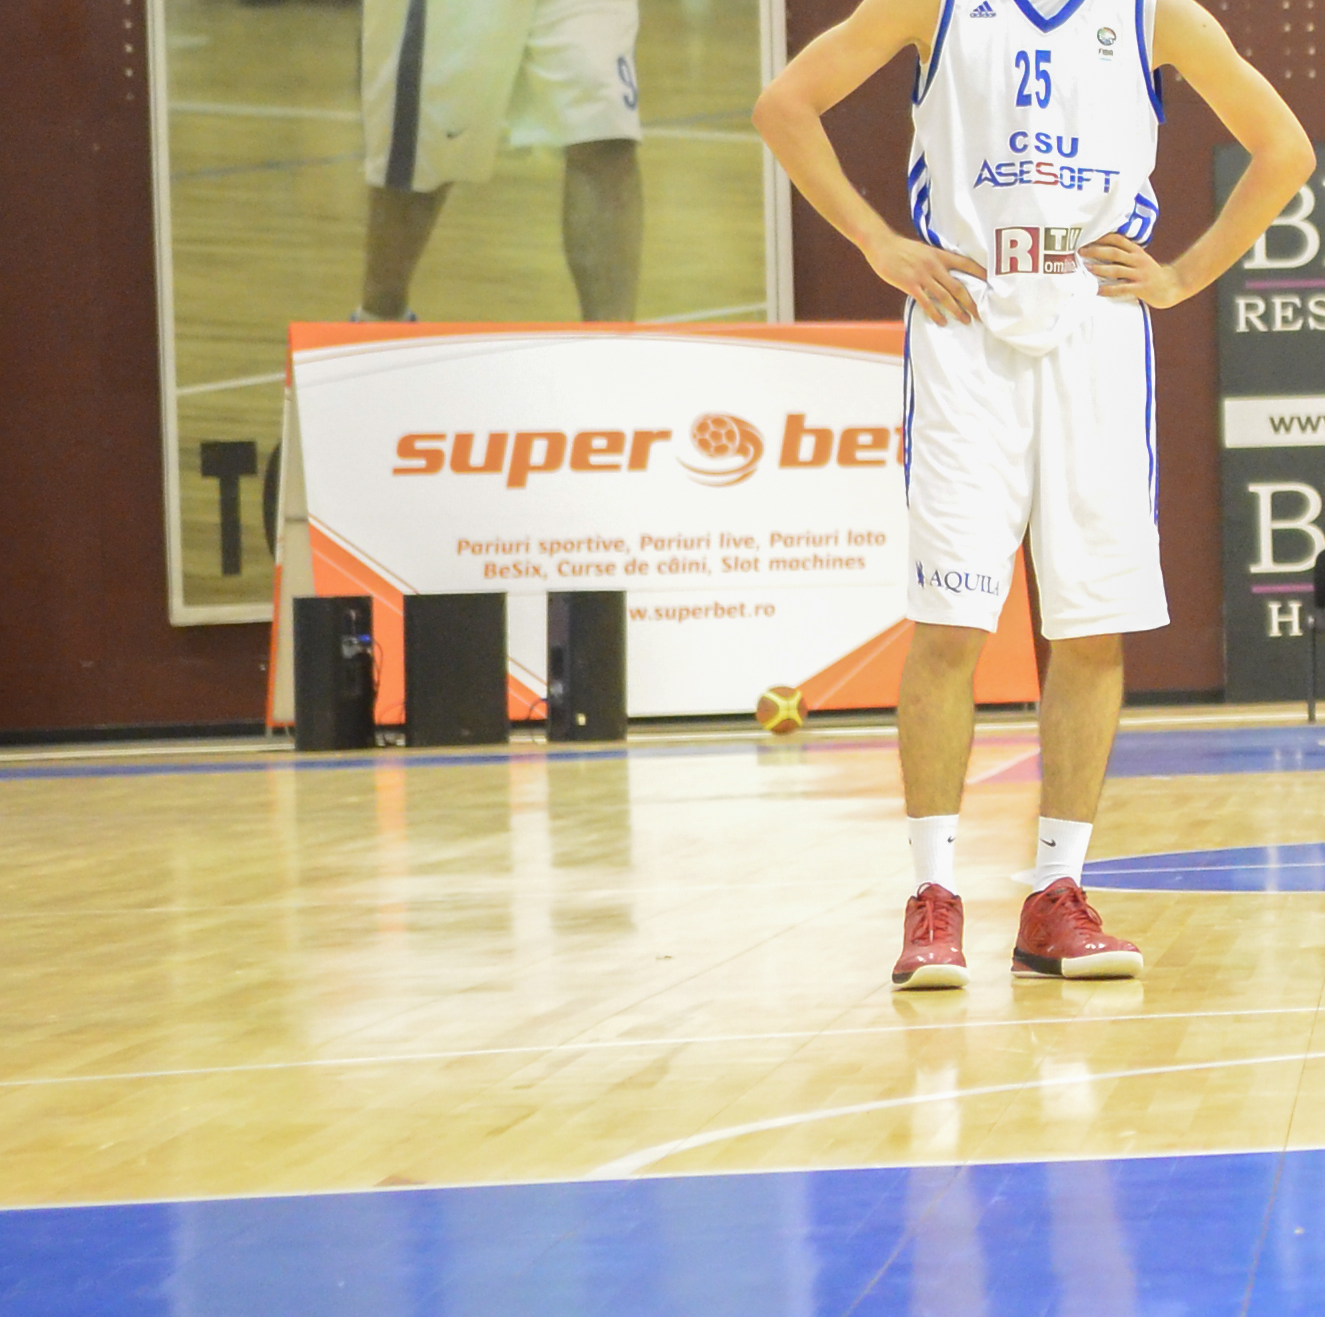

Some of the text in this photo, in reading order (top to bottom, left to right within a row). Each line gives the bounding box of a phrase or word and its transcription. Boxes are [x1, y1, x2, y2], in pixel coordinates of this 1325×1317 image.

[1014, 49, 1053, 110] 25
[1008, 130, 1080, 159] CSU
[972, 159, 1121, 194] ASESOFT
[1001, 228, 1033, 273] R
[392, 427, 673, 490] super
[457, 528, 887, 558] Pariuri sportive, Pariuri live, Pariuri loto
[483, 560, 549, 580] BeSix,
[556, 559, 617, 577] Curse
[624, 558, 650, 576] de
[721, 555, 761, 573] Slot
[768, 553, 868, 572] machines
[928, 568, 1000, 597] AQUILA
